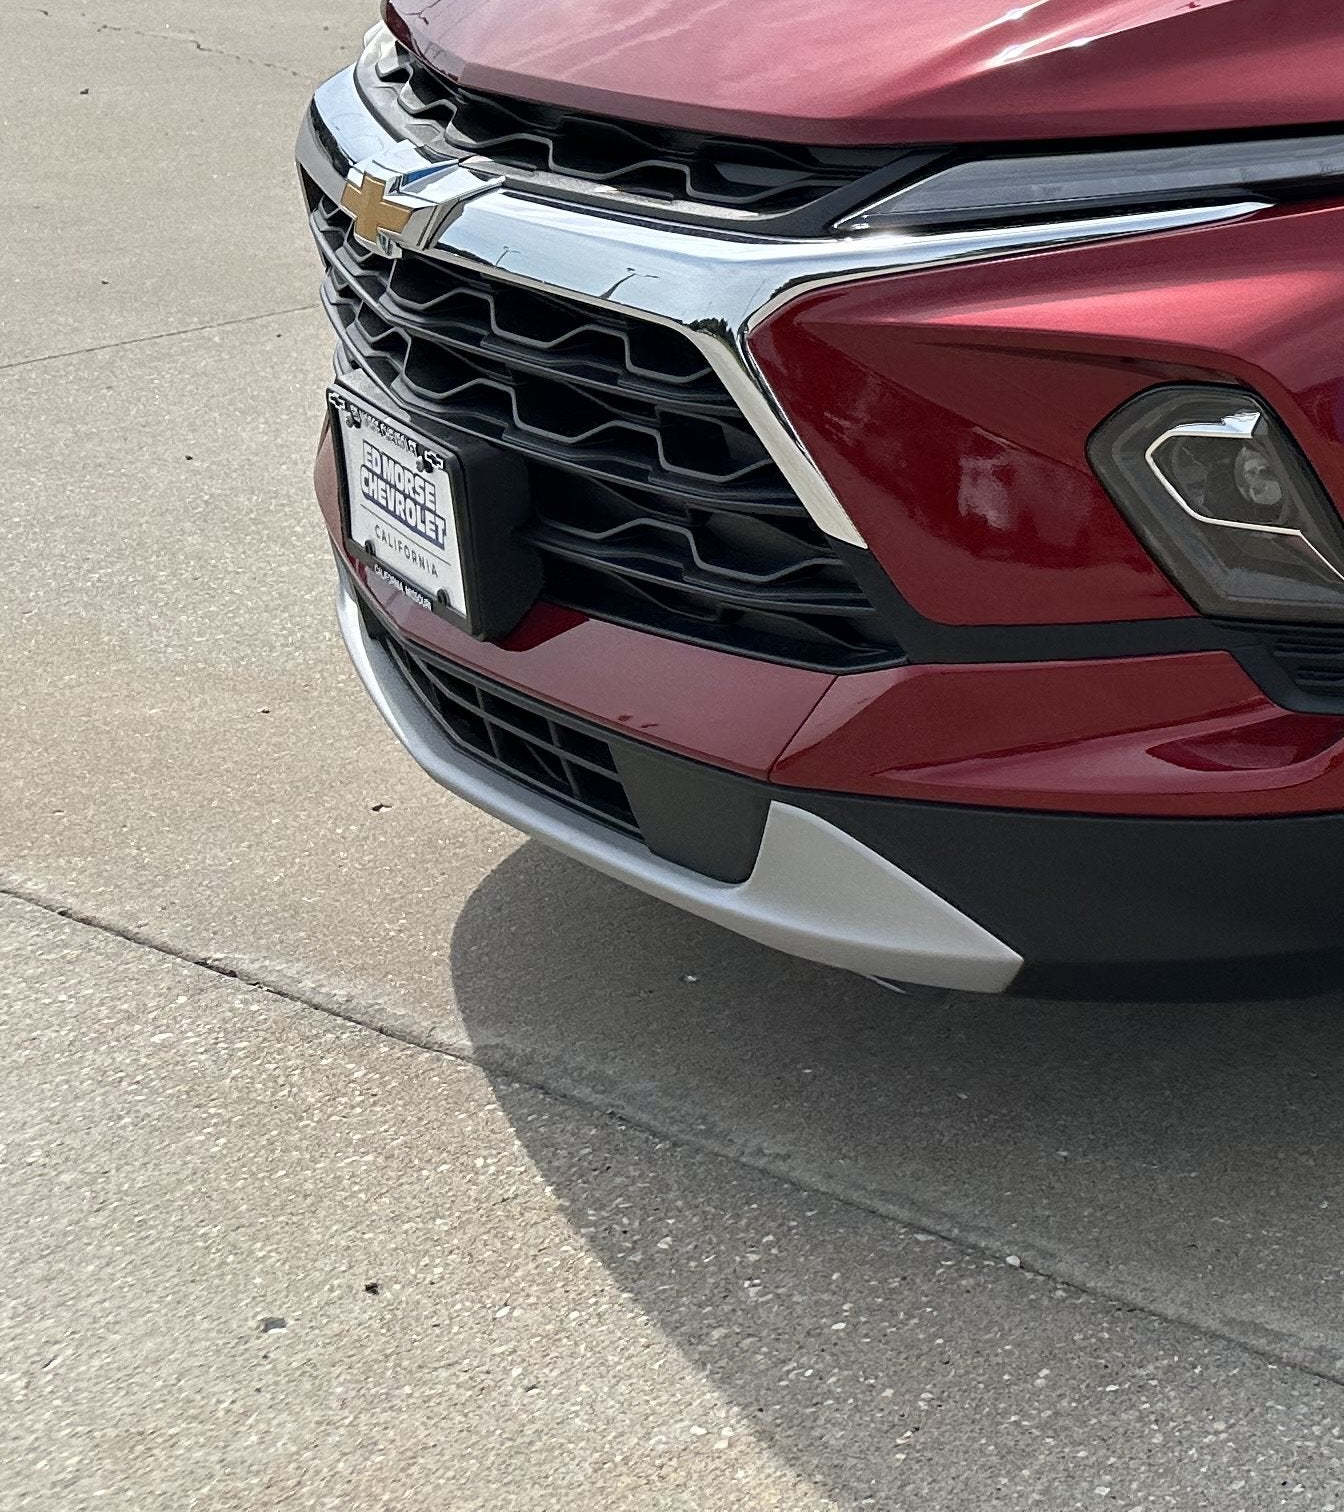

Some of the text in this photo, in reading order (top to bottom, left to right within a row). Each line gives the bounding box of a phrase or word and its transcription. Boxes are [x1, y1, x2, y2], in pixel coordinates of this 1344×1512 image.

[360, 464, 447, 549] CHEVROLET
[363, 439, 437, 512] ED MORSE
[374, 524, 439, 578] CALIFORNIA
